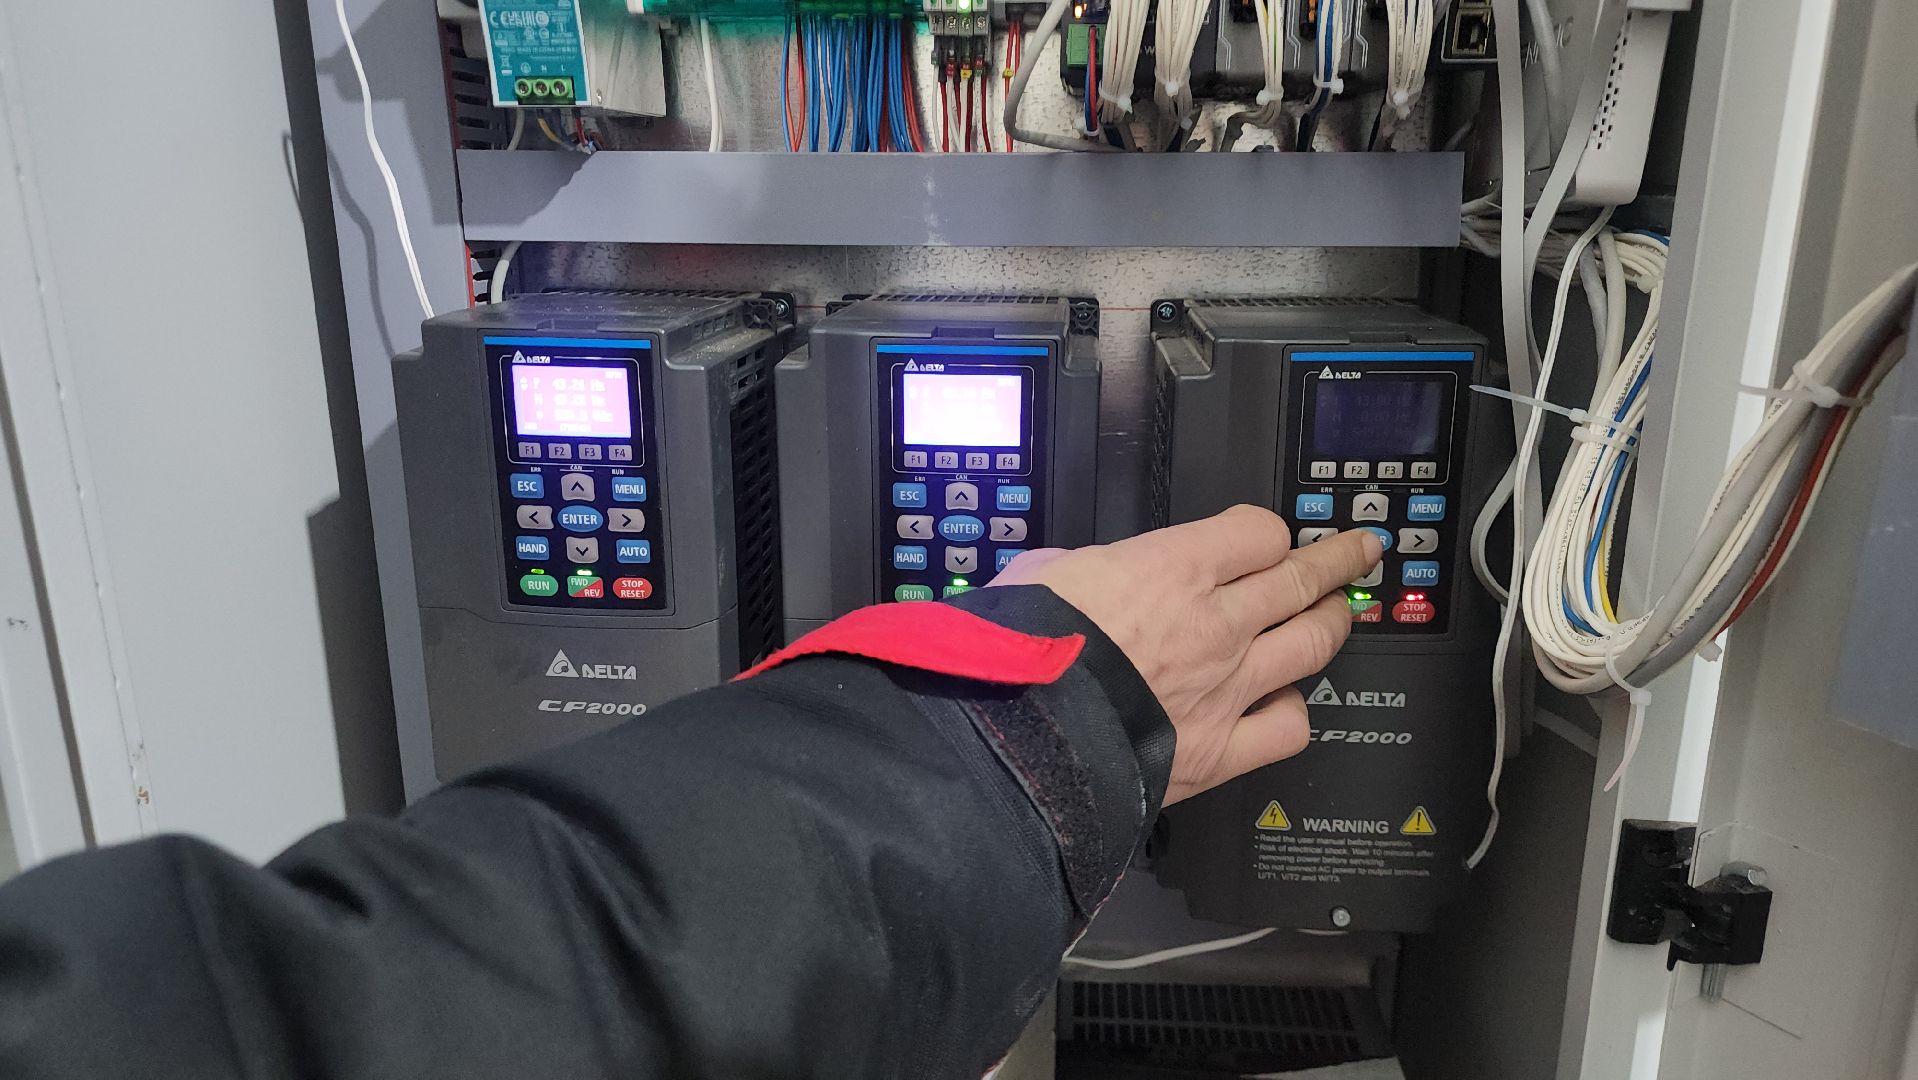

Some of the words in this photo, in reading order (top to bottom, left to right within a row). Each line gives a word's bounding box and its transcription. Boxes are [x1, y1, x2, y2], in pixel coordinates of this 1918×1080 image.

[525, 446, 535, 455] F1
[555, 447, 564, 456] F2
[584, 448, 595, 457] F3
[615, 449, 626, 457] F4
[911, 455, 921, 464] F1
[942, 456, 951, 464] F2
[972, 457, 982, 465] F3
[1002, 458, 1013, 466] F4
[1319, 466, 1329, 474] F1
[1352, 466, 1362, 475] F2
[1385, 466, 1395, 475] F3
[1417, 467, 1429, 475] F4
[518, 481, 537, 492] ESC
[615, 484, 643, 494] MENU
[900, 491, 919, 501] ESC
[1000, 493, 1028, 504] MENU
[1304, 502, 1325, 512] ESC
[1411, 503, 1441, 514] MENU
[563, 514, 597, 525] ENTER
[944, 523, 979, 534] ENTER
[518, 543, 546, 553] HAND
[620, 547, 647, 557] AUTO
[896, 553, 924, 563] HAND
[1406, 569, 1436, 578] AUTO
[528, 581, 549, 590] RUN
[584, 589, 600, 597] REV
[903, 590, 924, 600] RUN
[1352, 602, 1367, 610] WD
[1361, 613, 1378, 621] REV
[1401, 614, 1427, 622] RESET
[582, 664, 636, 680] DELTA
[1346, 692, 1405, 707] DELTA
[538, 700, 646, 716] CP2000
[1303, 818, 1389, 834] WARNING
[1260, 834, 1281, 842] Read
[1258, 855, 1295, 863] removing
